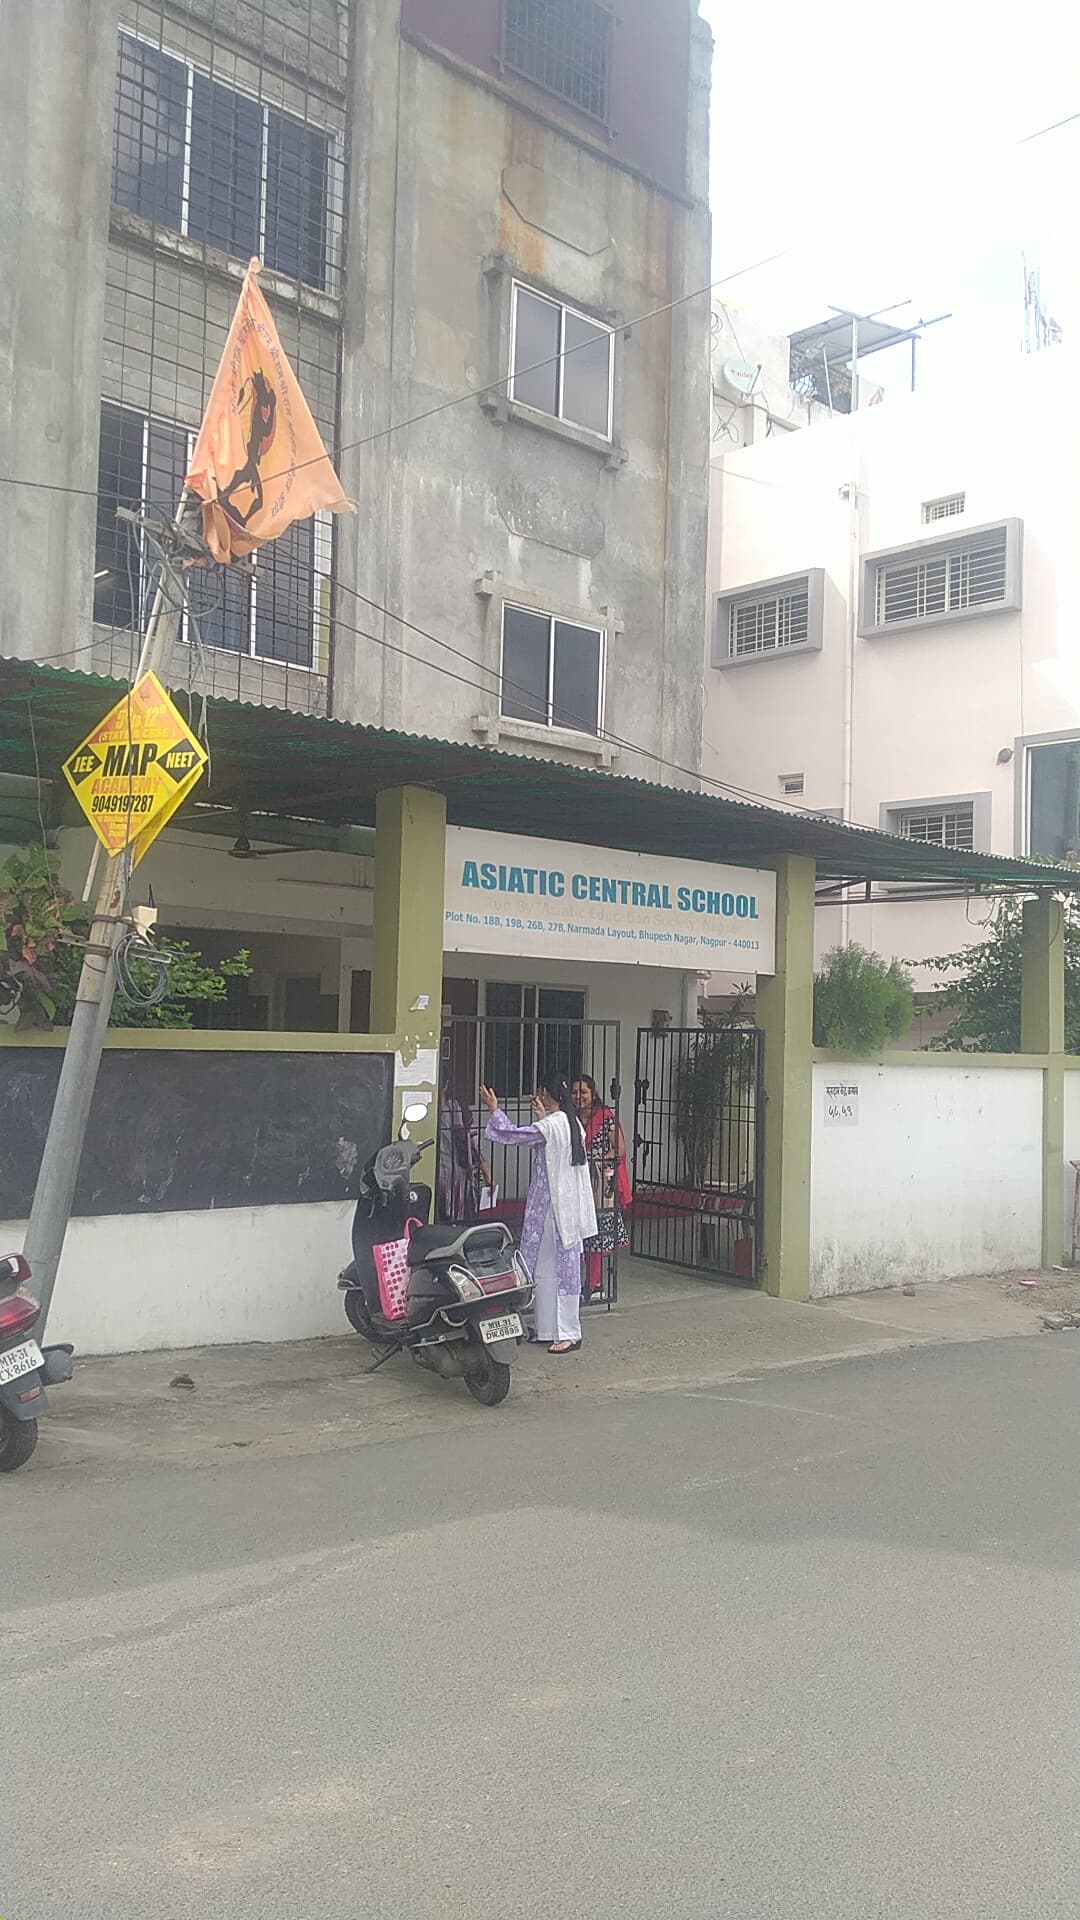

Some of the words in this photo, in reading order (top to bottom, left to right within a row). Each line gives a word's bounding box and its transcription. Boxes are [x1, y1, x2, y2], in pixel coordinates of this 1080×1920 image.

[72, 756, 94, 773] JEE
[102, 744, 158, 777] MAP
[166, 752, 196, 768] NEET
[91, 777, 160, 794] ACADEMY
[92, 795, 154, 812] 9049197287
[462, 861, 565, 897] ASIATIC
[572, 874, 672, 909] CENTRAL
[677, 887, 759, 919] SCHOOL
[445, 912, 464, 922] Plot
[466, 914, 480, 924] No.
[484, 915, 502, 927] 18B,
[506, 918, 524, 930] 19B,
[527, 920, 545, 932] 26B,
[548, 922, 566, 934] 27B,
[568, 923, 605, 936] Narmada
[607, 927, 637, 939] Layout,
[639, 930, 672, 945] Bhupesh
[674, 934, 698, 946] Nagar,
[700, 936, 726, 948] Nagpur
[733, 939, 760, 950] 440013
